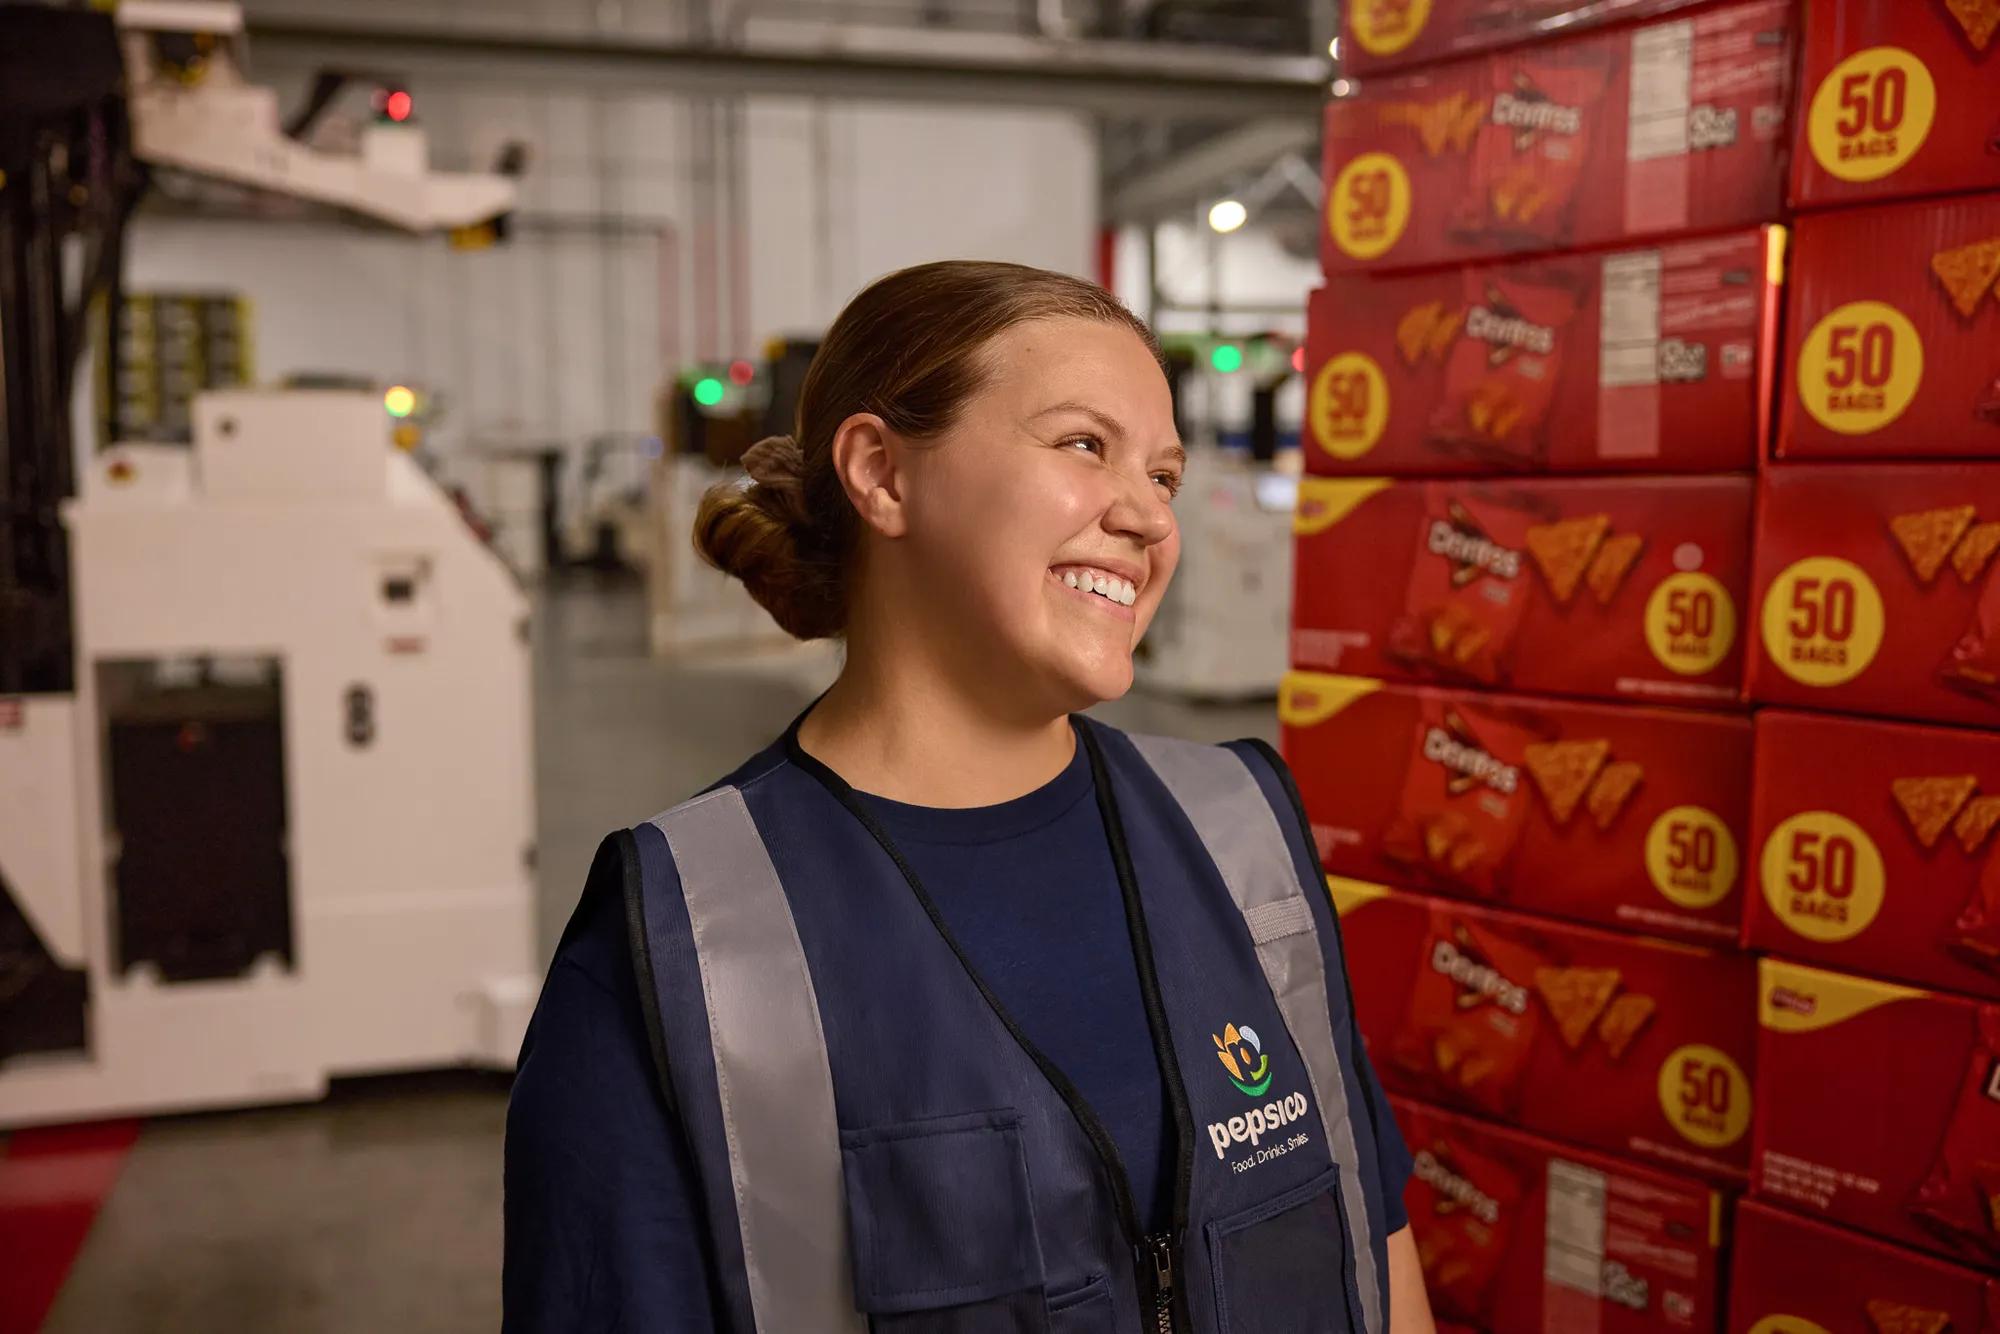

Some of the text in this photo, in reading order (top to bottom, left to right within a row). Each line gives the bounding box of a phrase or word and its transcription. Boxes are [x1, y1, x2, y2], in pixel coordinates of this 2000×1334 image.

[1837, 66, 1907, 137] 50
[1838, 137, 1898, 162] BAGS
[1825, 321, 1895, 389] 50
[1667, 588, 1714, 638] 50
[1790, 577, 1856, 642] 50
[1667, 820, 1716, 875] 50
[1788, 831, 1856, 900] 50
[1679, 1058, 1730, 1114] 50
[1208, 1091, 1308, 1160] pepsico
[1231, 1154, 1256, 1174] Food.
[1257, 1144, 1287, 1164] Drinks.
